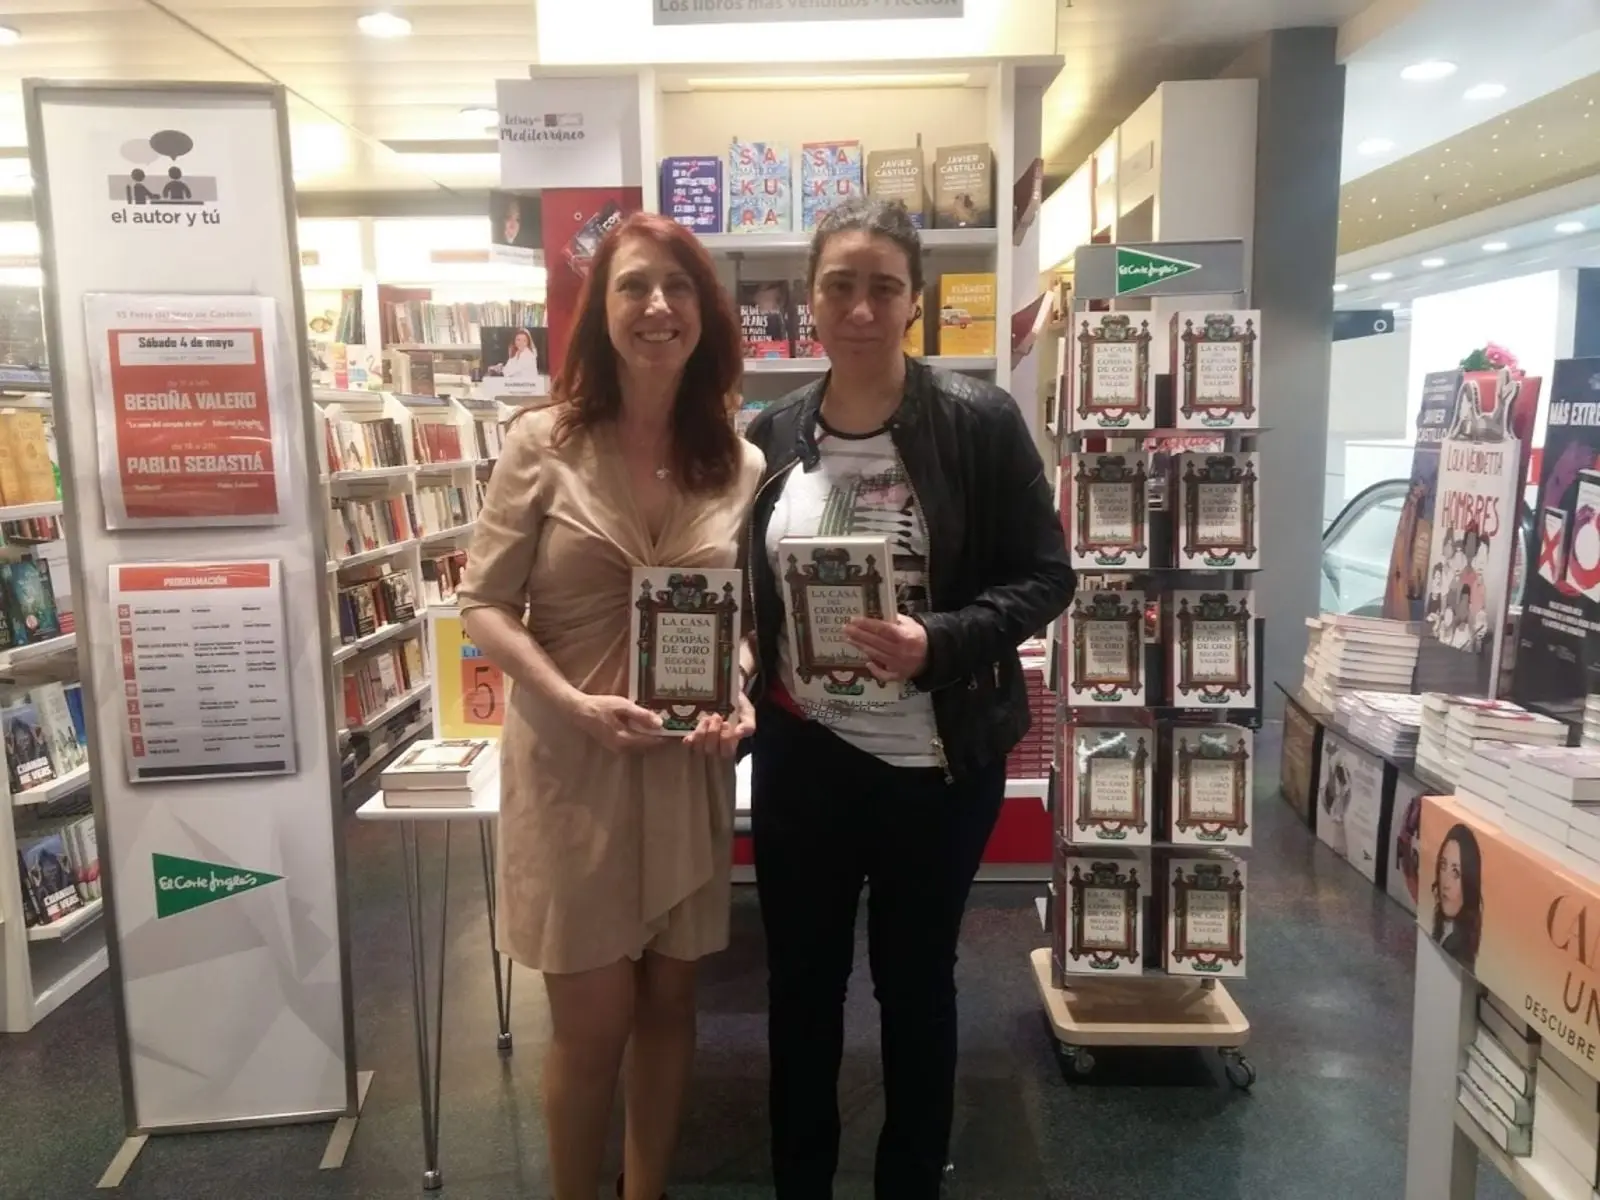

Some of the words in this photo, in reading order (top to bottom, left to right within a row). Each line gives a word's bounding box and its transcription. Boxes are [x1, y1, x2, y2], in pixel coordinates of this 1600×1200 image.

[659, 0, 689, 12] Los
[880, 159, 913, 169] JAVIER
[946, 154, 979, 165] JAVIER
[874, 168, 919, 178] CASTILLO
[940, 163, 985, 173] CASTILLO
[111, 209, 127, 223] el
[132, 210, 181, 224] autor
[186, 212, 197, 227] y
[202, 209, 220, 224] tú
[1128, 264, 1148, 275] Corte
[138, 337, 177, 348] Sábado
[180, 338, 188, 347] 4
[190, 337, 203, 347] de
[206, 339, 234, 349] mayo
[124, 390, 192, 411] BEGOÑA
[195, 392, 257, 410] VALERO
[1549, 399, 1570, 425] MÁS
[127, 456, 181, 474] PABLO
[185, 451, 264, 473] SEBASTIÁ
[1447, 446, 1465, 473] LOLA
[1466, 448, 1503, 477] VENDETTA
[1442, 489, 1500, 537] HOMBRES
[164, 575, 228, 587] PROGRAMACIÓN
[812, 590, 826, 598] LA
[828, 590, 858, 598] CASA
[662, 617, 676, 626] LA
[680, 618, 711, 627] CASA
[815, 616, 832, 624] DE
[834, 616, 852, 624] OR
[662, 645, 681, 654] DE
[682, 646, 710, 655] ORO
[664, 657, 706, 665] BEGOÑA
[664, 667, 706, 675] VALERO
[473, 666, 495, 719] 5
[159, 876, 173, 890] El
[175, 876, 208, 889] Corte
[209, 871, 257, 892] Inglés
[1525, 994, 1597, 1062] DESCUBRE
